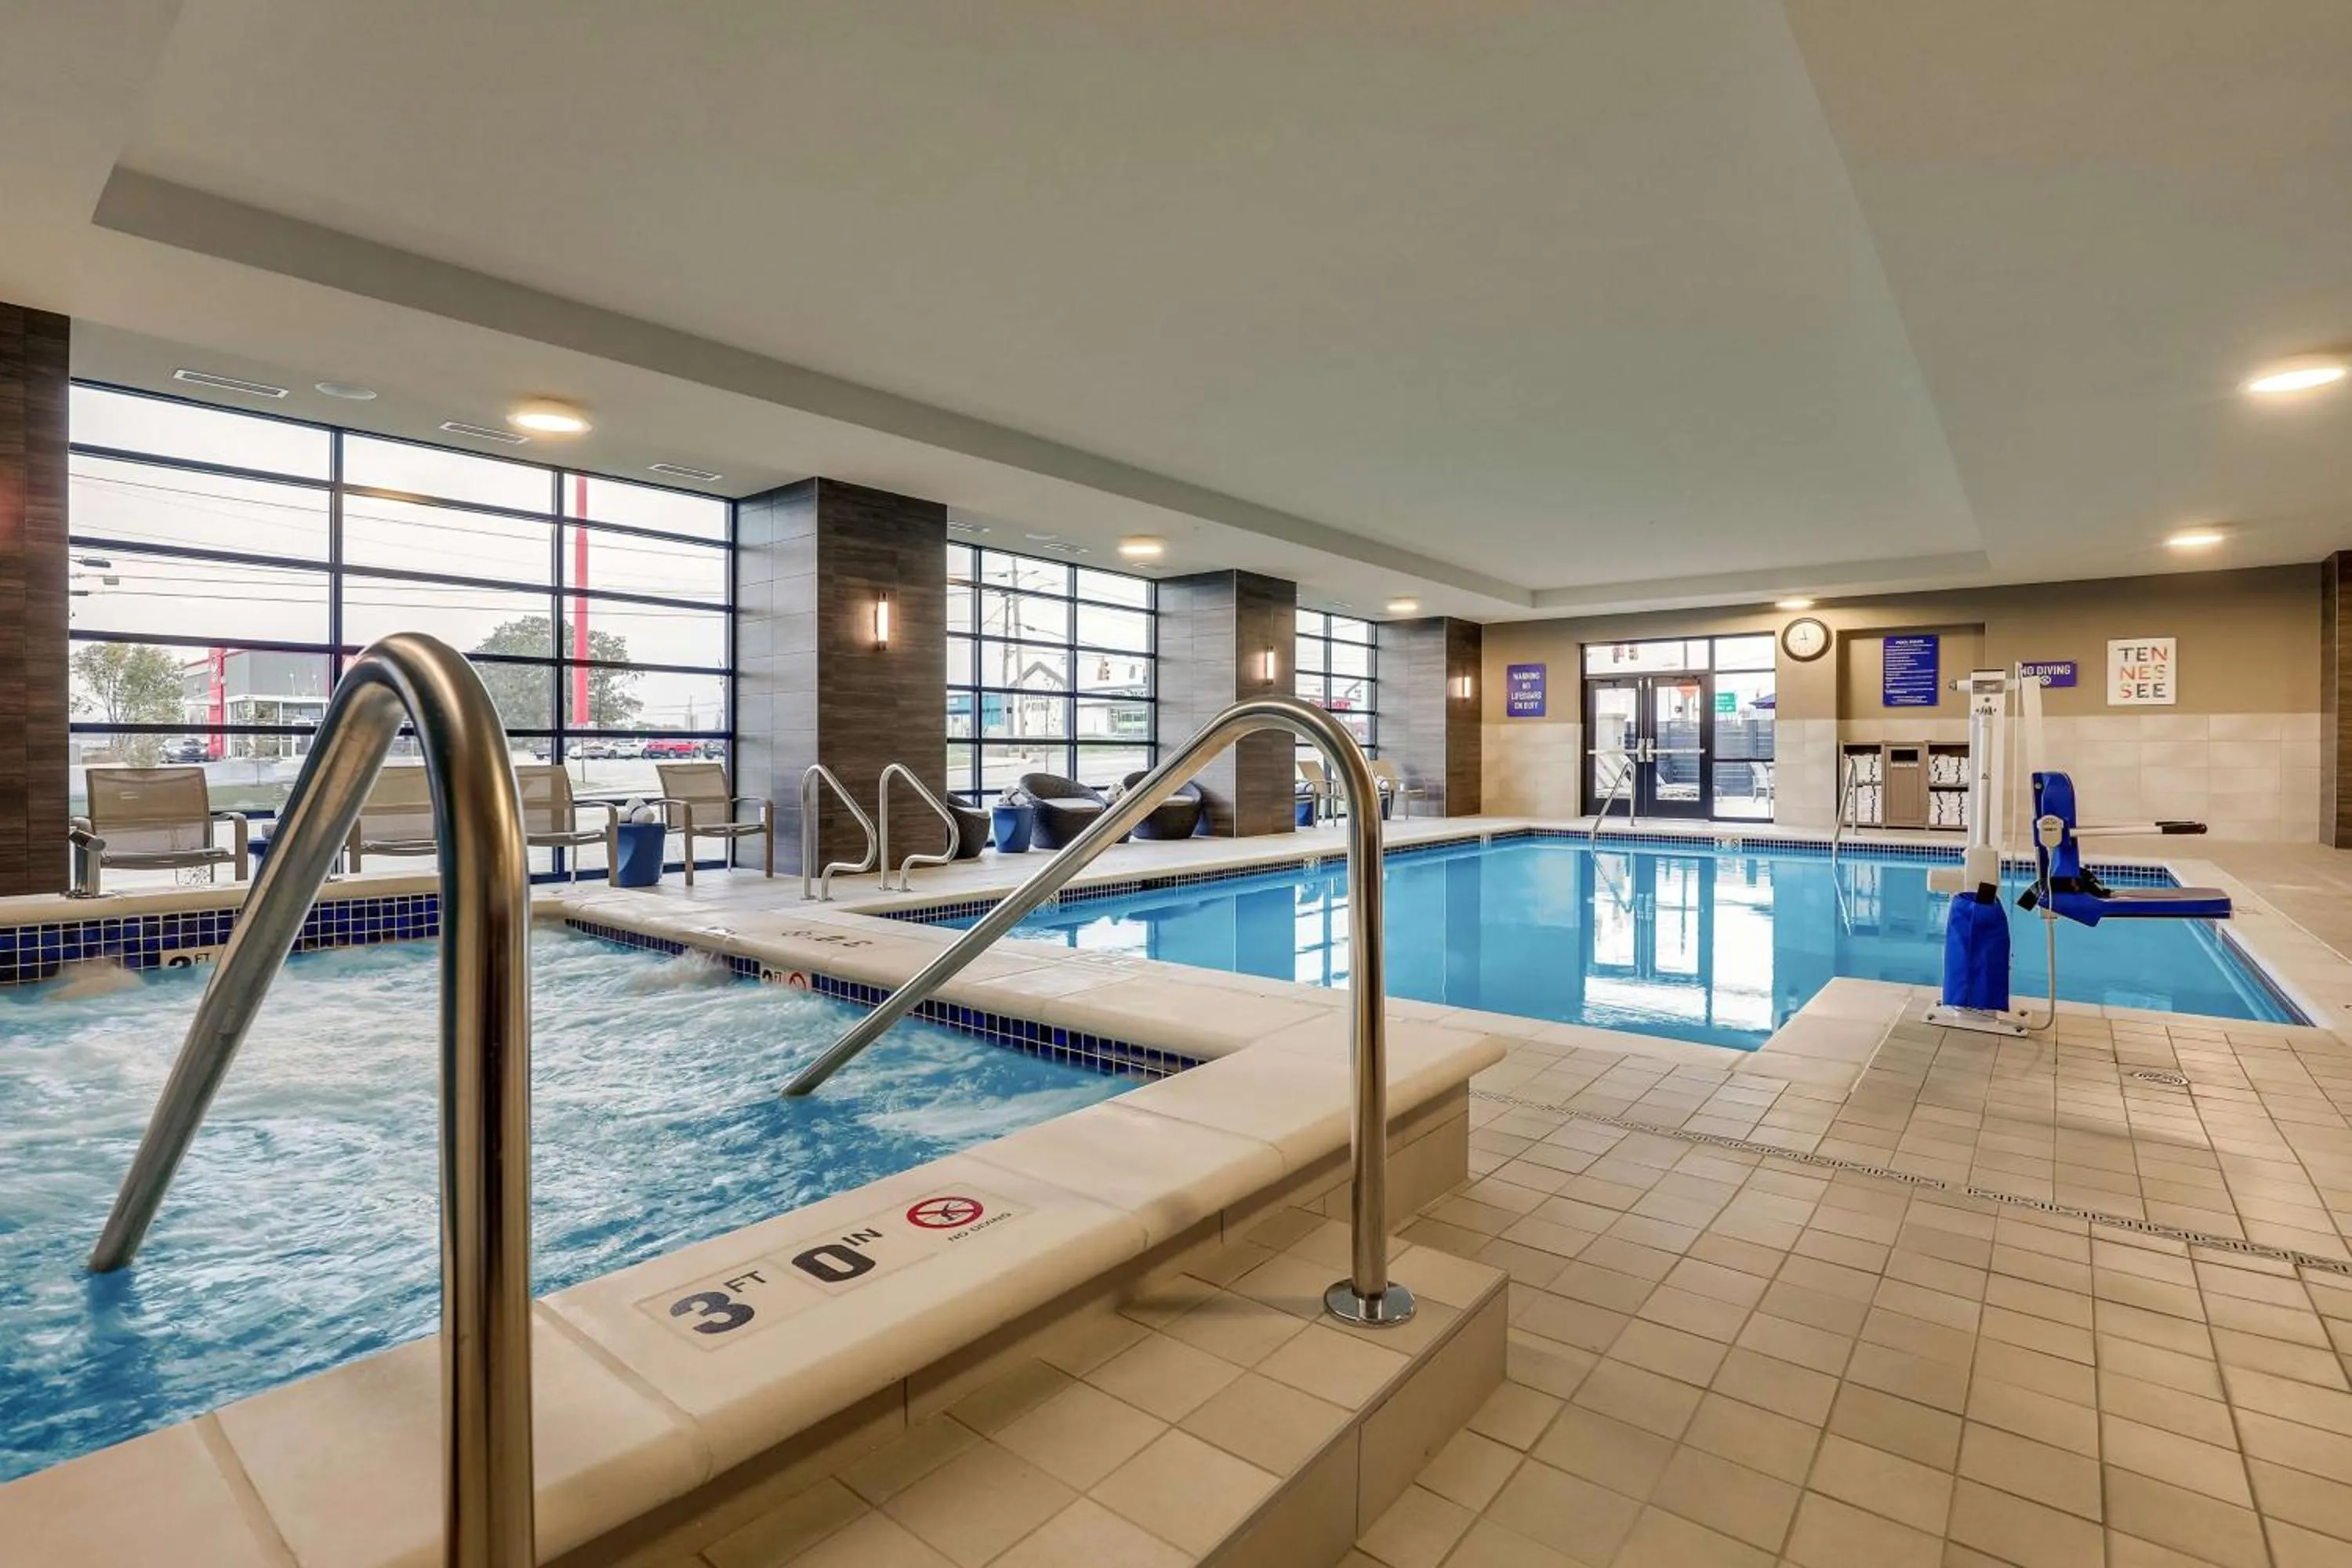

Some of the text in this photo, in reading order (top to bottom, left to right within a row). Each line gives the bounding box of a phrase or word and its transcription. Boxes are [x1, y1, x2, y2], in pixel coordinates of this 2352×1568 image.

[2117, 647, 2168, 662] TEN
[2036, 664, 2071, 675] DIVING
[2119, 664, 2166, 681] NES
[2119, 683, 2167, 699] SEE
